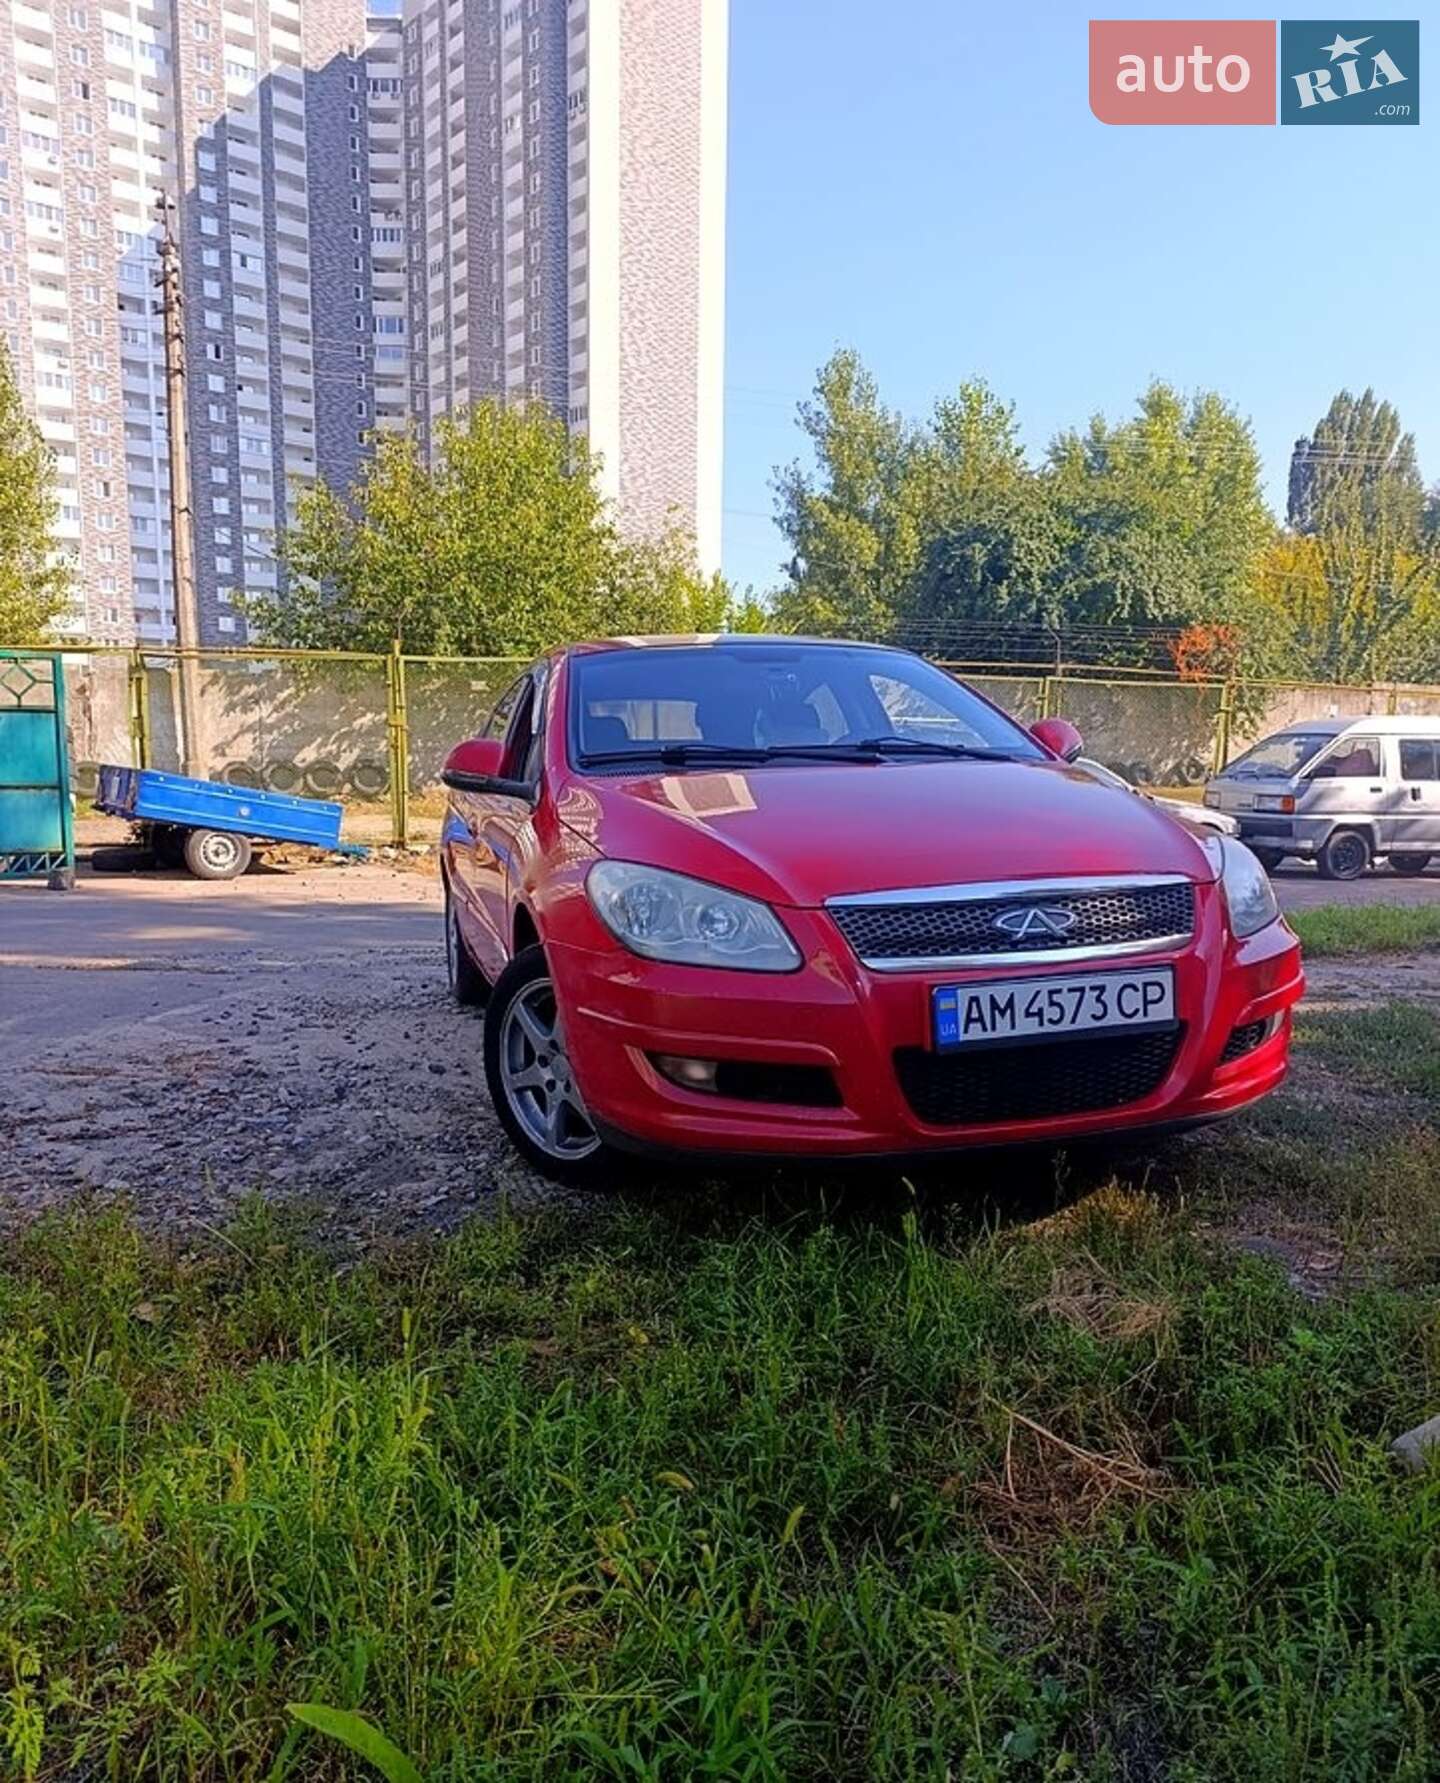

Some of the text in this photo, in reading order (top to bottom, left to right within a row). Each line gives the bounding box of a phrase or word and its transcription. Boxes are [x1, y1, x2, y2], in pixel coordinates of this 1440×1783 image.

[963, 981, 1166, 1034] AM 4573 CP
[940, 1023, 957, 1036] UA
